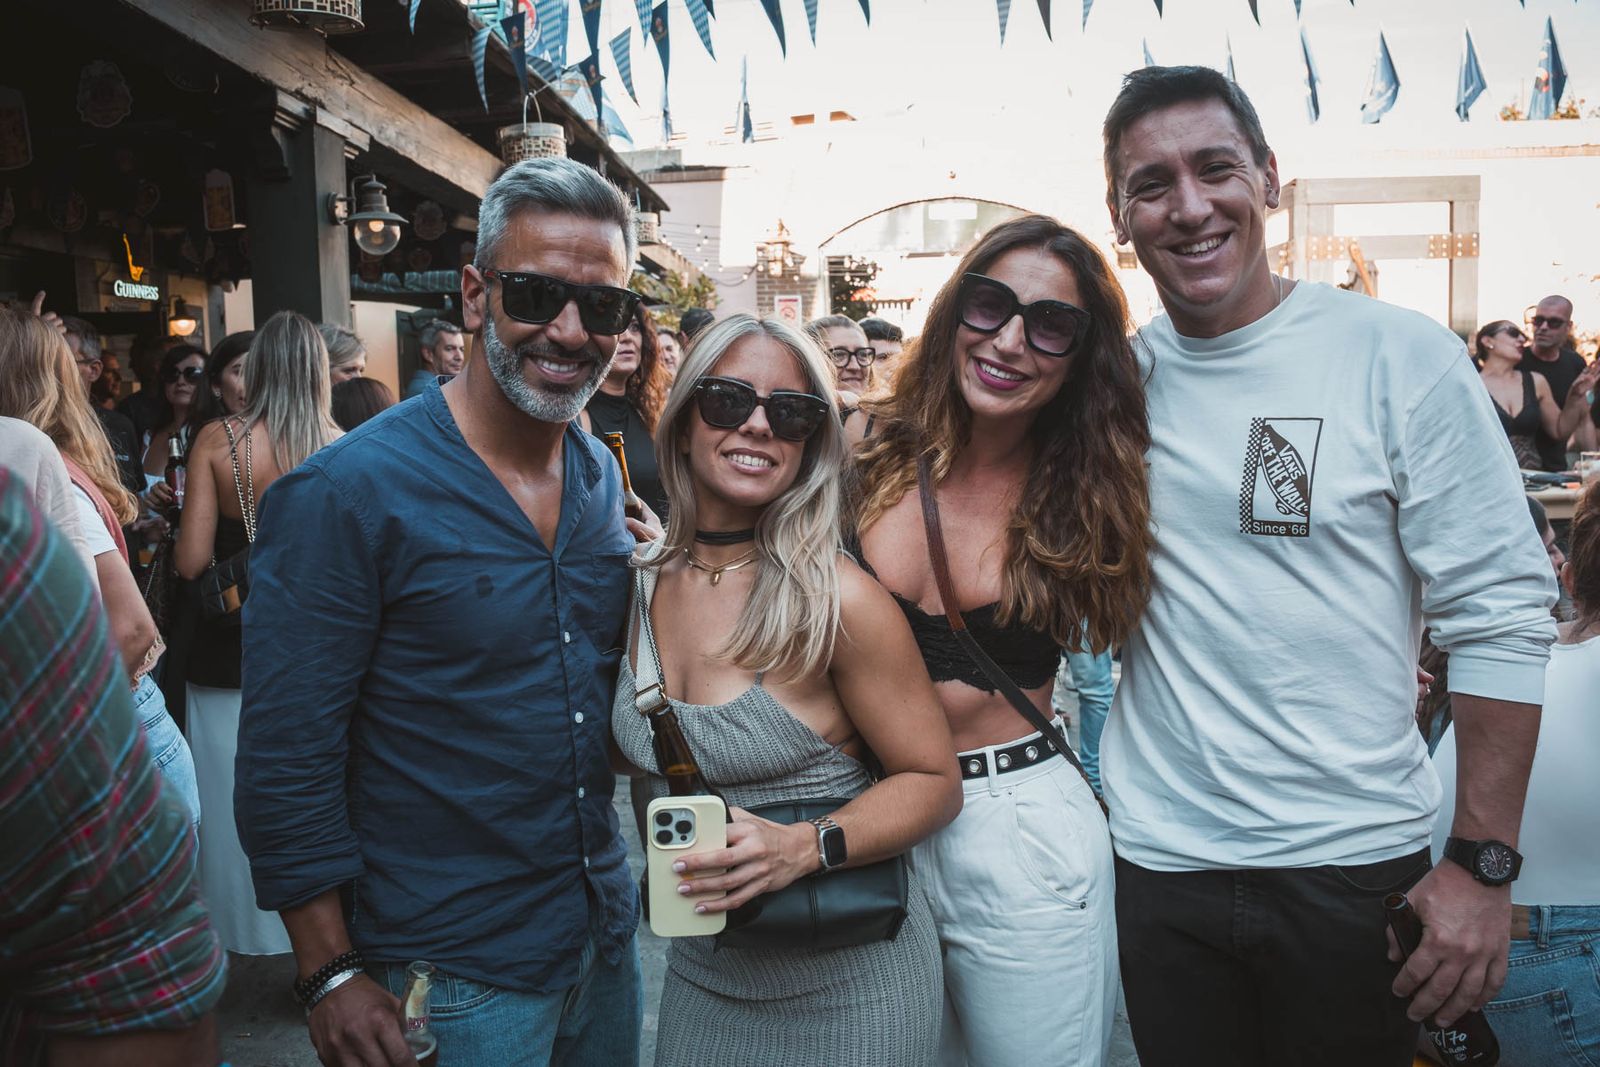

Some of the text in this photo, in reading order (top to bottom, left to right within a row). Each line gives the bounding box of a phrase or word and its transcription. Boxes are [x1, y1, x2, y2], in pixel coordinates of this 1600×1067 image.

[114, 280, 159, 300] GUINNESS
[1266, 455, 1289, 485] THE
[1279, 444, 1305, 480] VANS
[1252, 521, 1287, 534] Since
